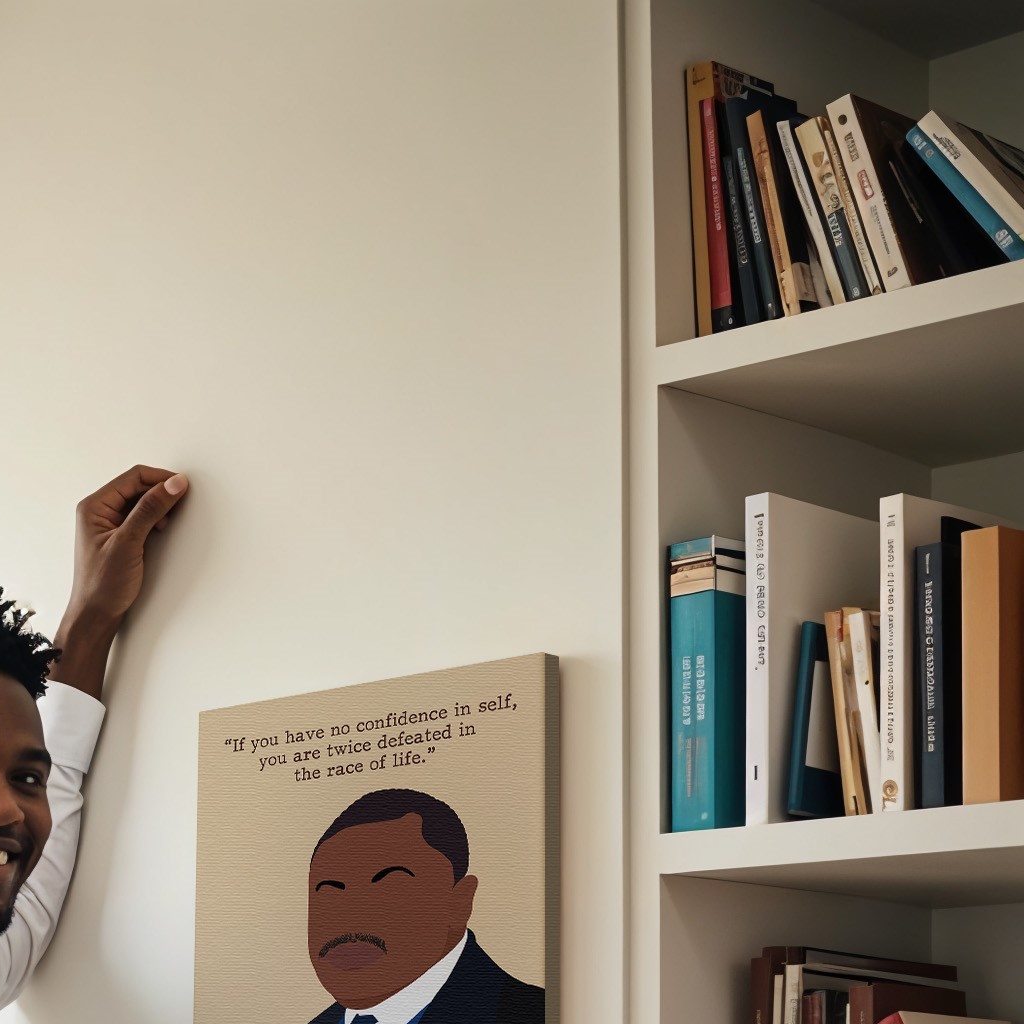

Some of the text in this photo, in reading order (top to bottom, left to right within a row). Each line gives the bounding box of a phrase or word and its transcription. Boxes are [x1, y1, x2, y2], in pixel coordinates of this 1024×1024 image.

[224, 693, 518, 754] “If you have no confidence in self,
[259, 721, 477, 771] you are twice defeated in
[294, 746, 436, 782] the race of life.”
